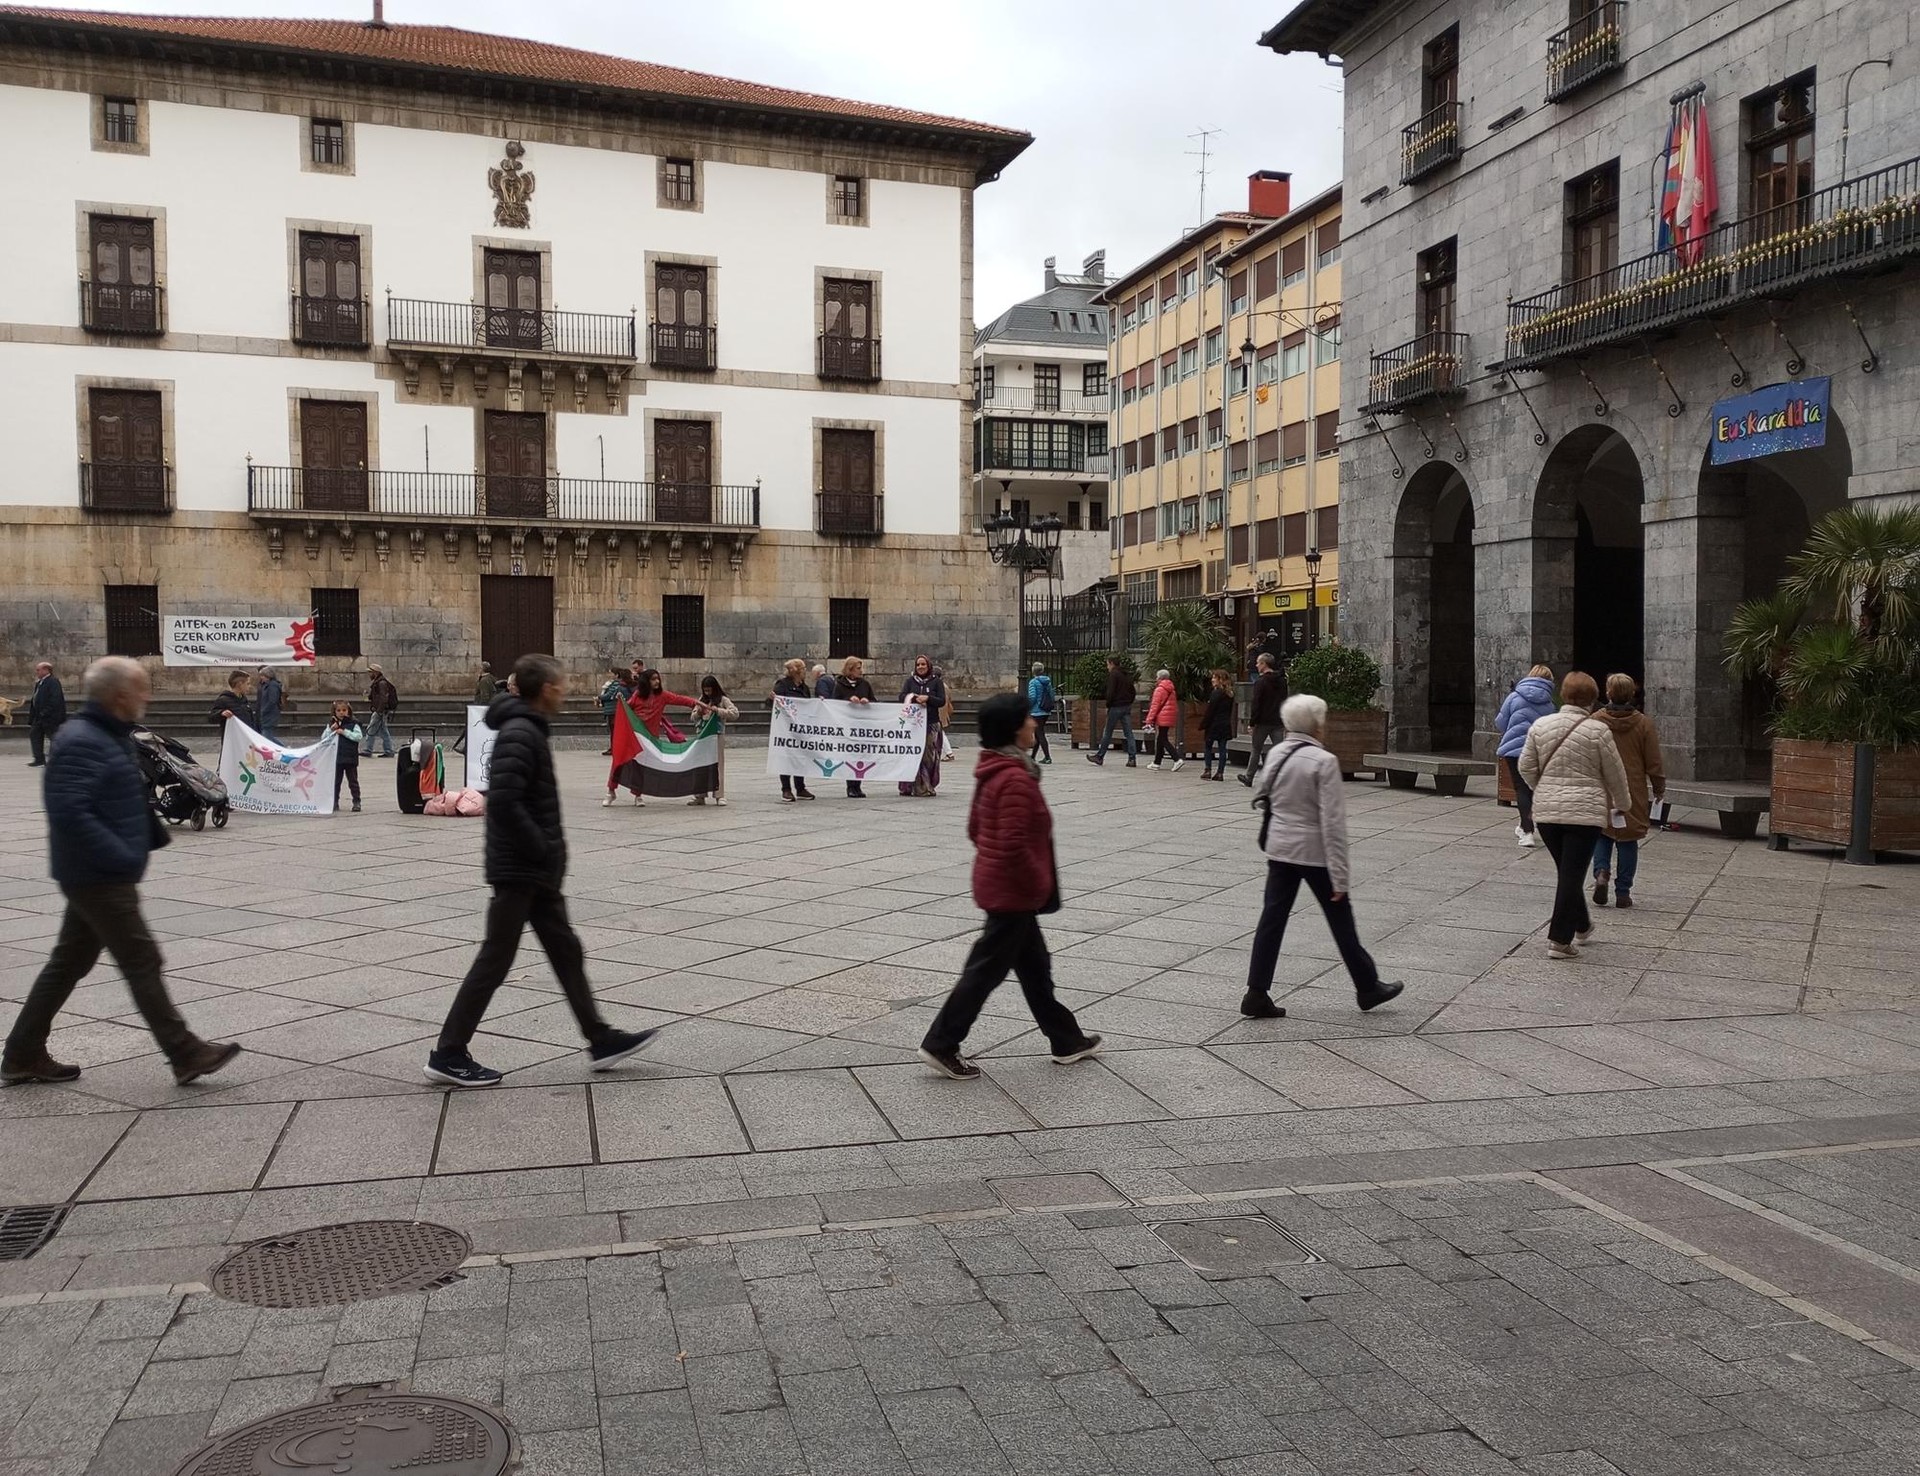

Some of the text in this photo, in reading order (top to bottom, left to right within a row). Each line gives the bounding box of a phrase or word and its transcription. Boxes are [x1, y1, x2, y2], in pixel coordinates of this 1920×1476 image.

[1718, 399, 1821, 442] Euskaraldia
[174, 620, 275, 629] AITEK-en 2025ean
[174, 632, 260, 642] EZER KOBRATU
[174, 645, 207, 654] GABE
[789, 723, 845, 737] HARRERA
